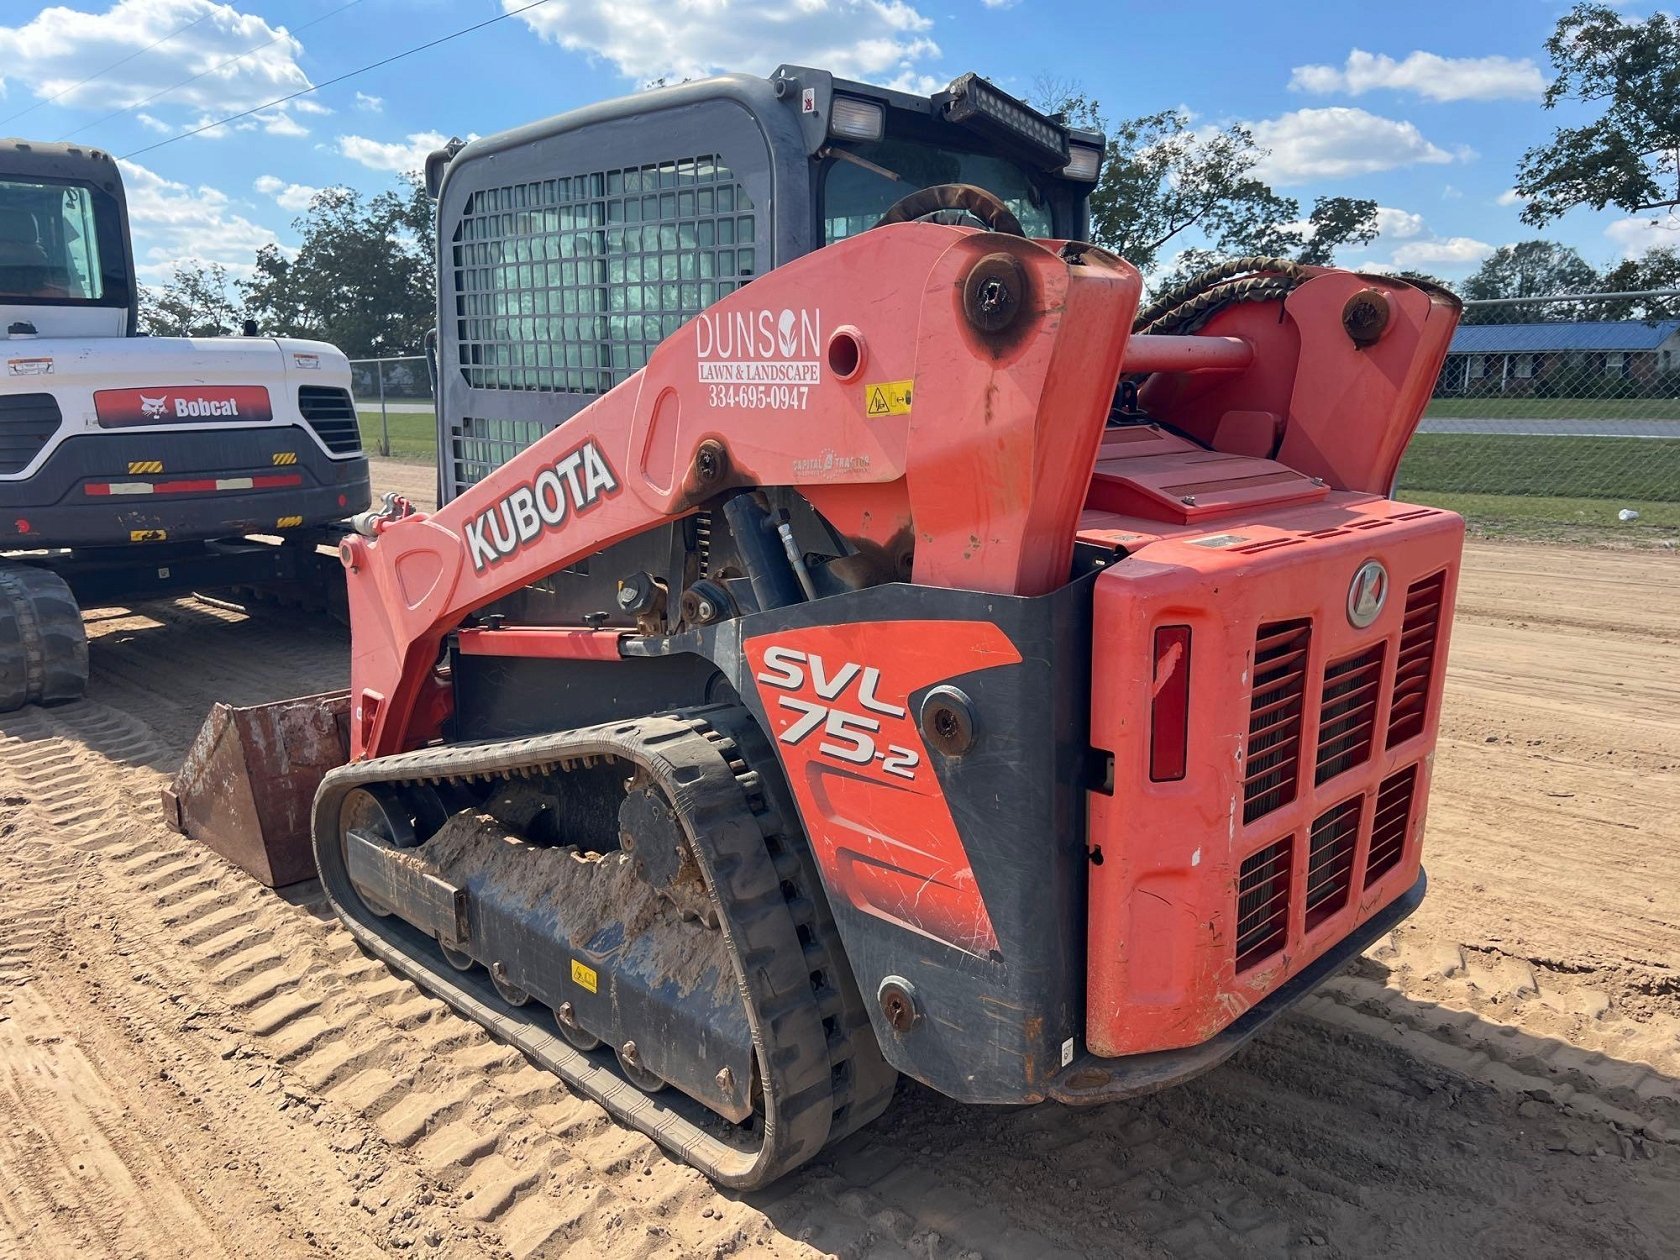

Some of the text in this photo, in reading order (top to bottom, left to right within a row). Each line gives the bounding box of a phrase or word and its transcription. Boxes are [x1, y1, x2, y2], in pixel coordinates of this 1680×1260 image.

[696, 308, 821, 359] DUNSON
[700, 364, 819, 381] LAWN & LANDSCAPE
[174, 398, 239, 417] Bobcat
[708, 384, 809, 410] 334-695-0947
[465, 442, 618, 571] KUBOTA
[757, 646, 906, 719] SVL
